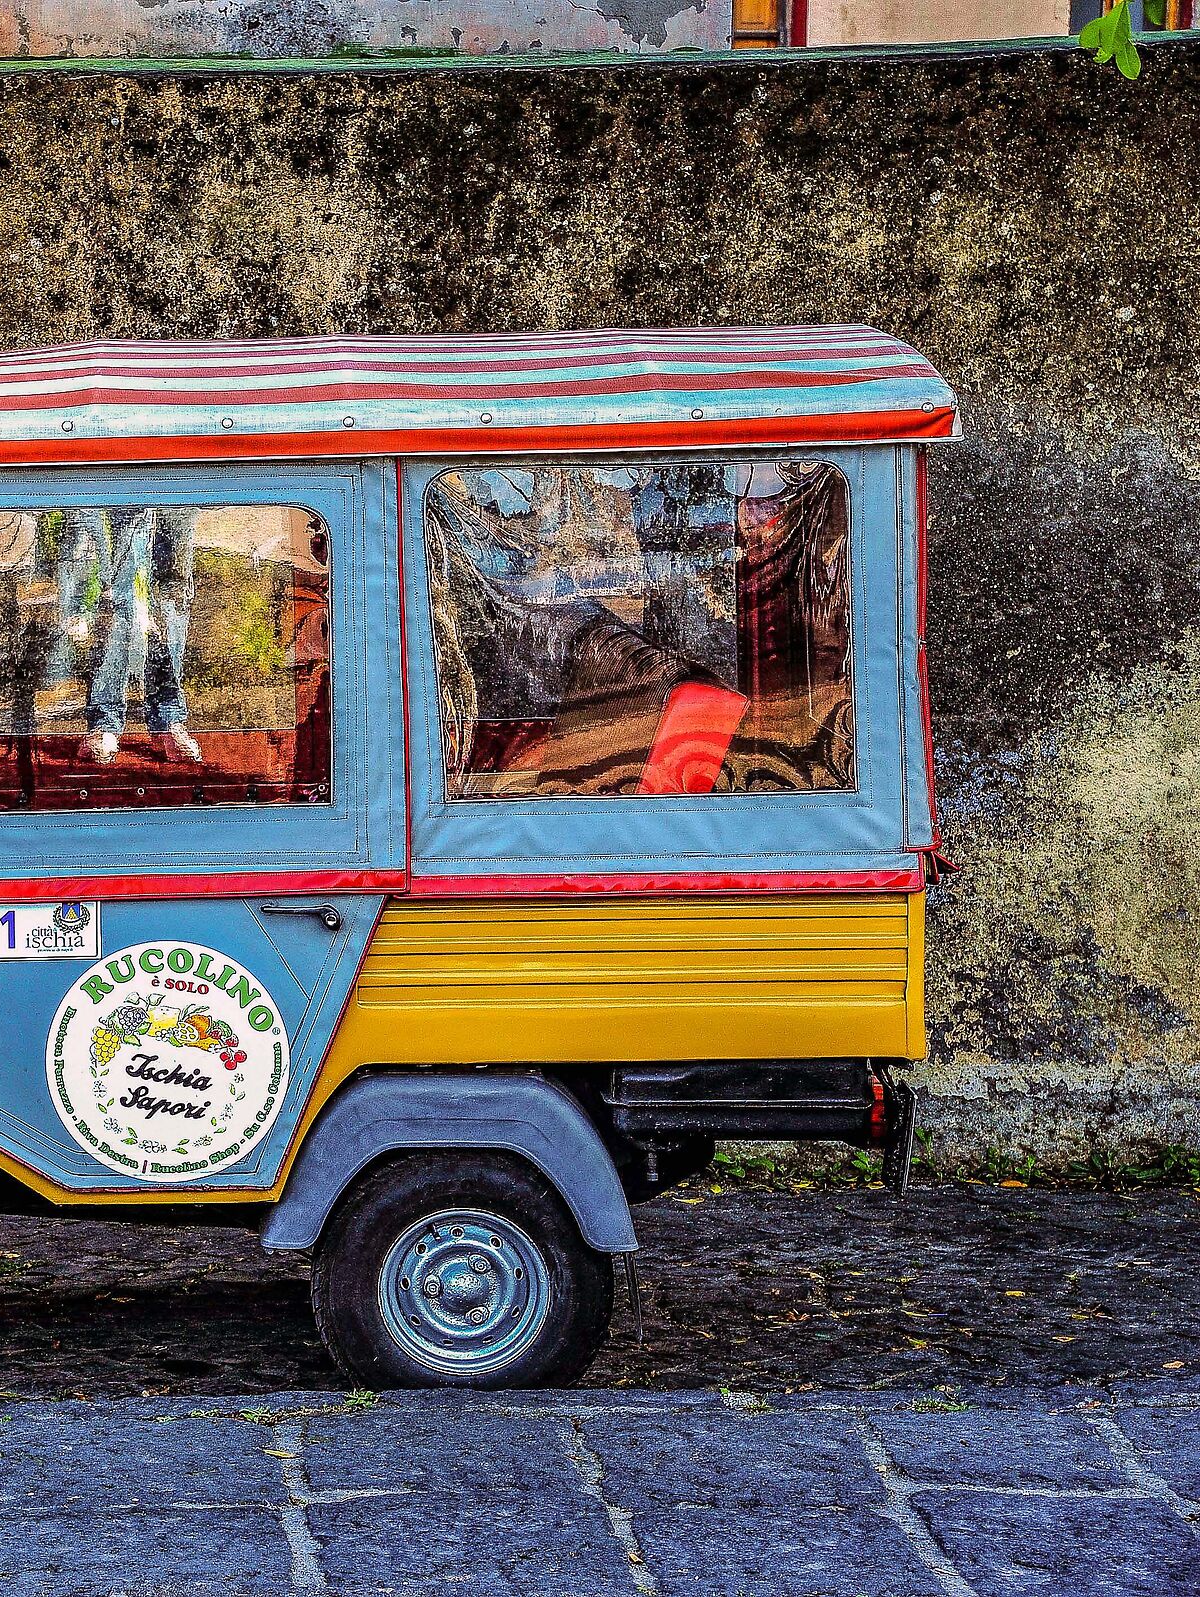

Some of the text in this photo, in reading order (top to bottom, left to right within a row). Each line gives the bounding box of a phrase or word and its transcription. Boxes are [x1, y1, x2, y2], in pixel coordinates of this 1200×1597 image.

[25, 930, 86, 949] ischia
[80, 948, 275, 1032] RUCOLINO
[151, 975, 210, 996] è SOLO
[53, 1005, 77, 1058] Enoteca
[75, 1119, 99, 1147] Riva
[150, 1158, 209, 1174] Rucolino
[208, 1142, 241, 1165] Shop
[243, 1122, 261, 1140] Su
[267, 1041, 282, 1095] Colonna
[125, 1053, 213, 1091] Ischia
[119, 1085, 212, 1120] Sapori
